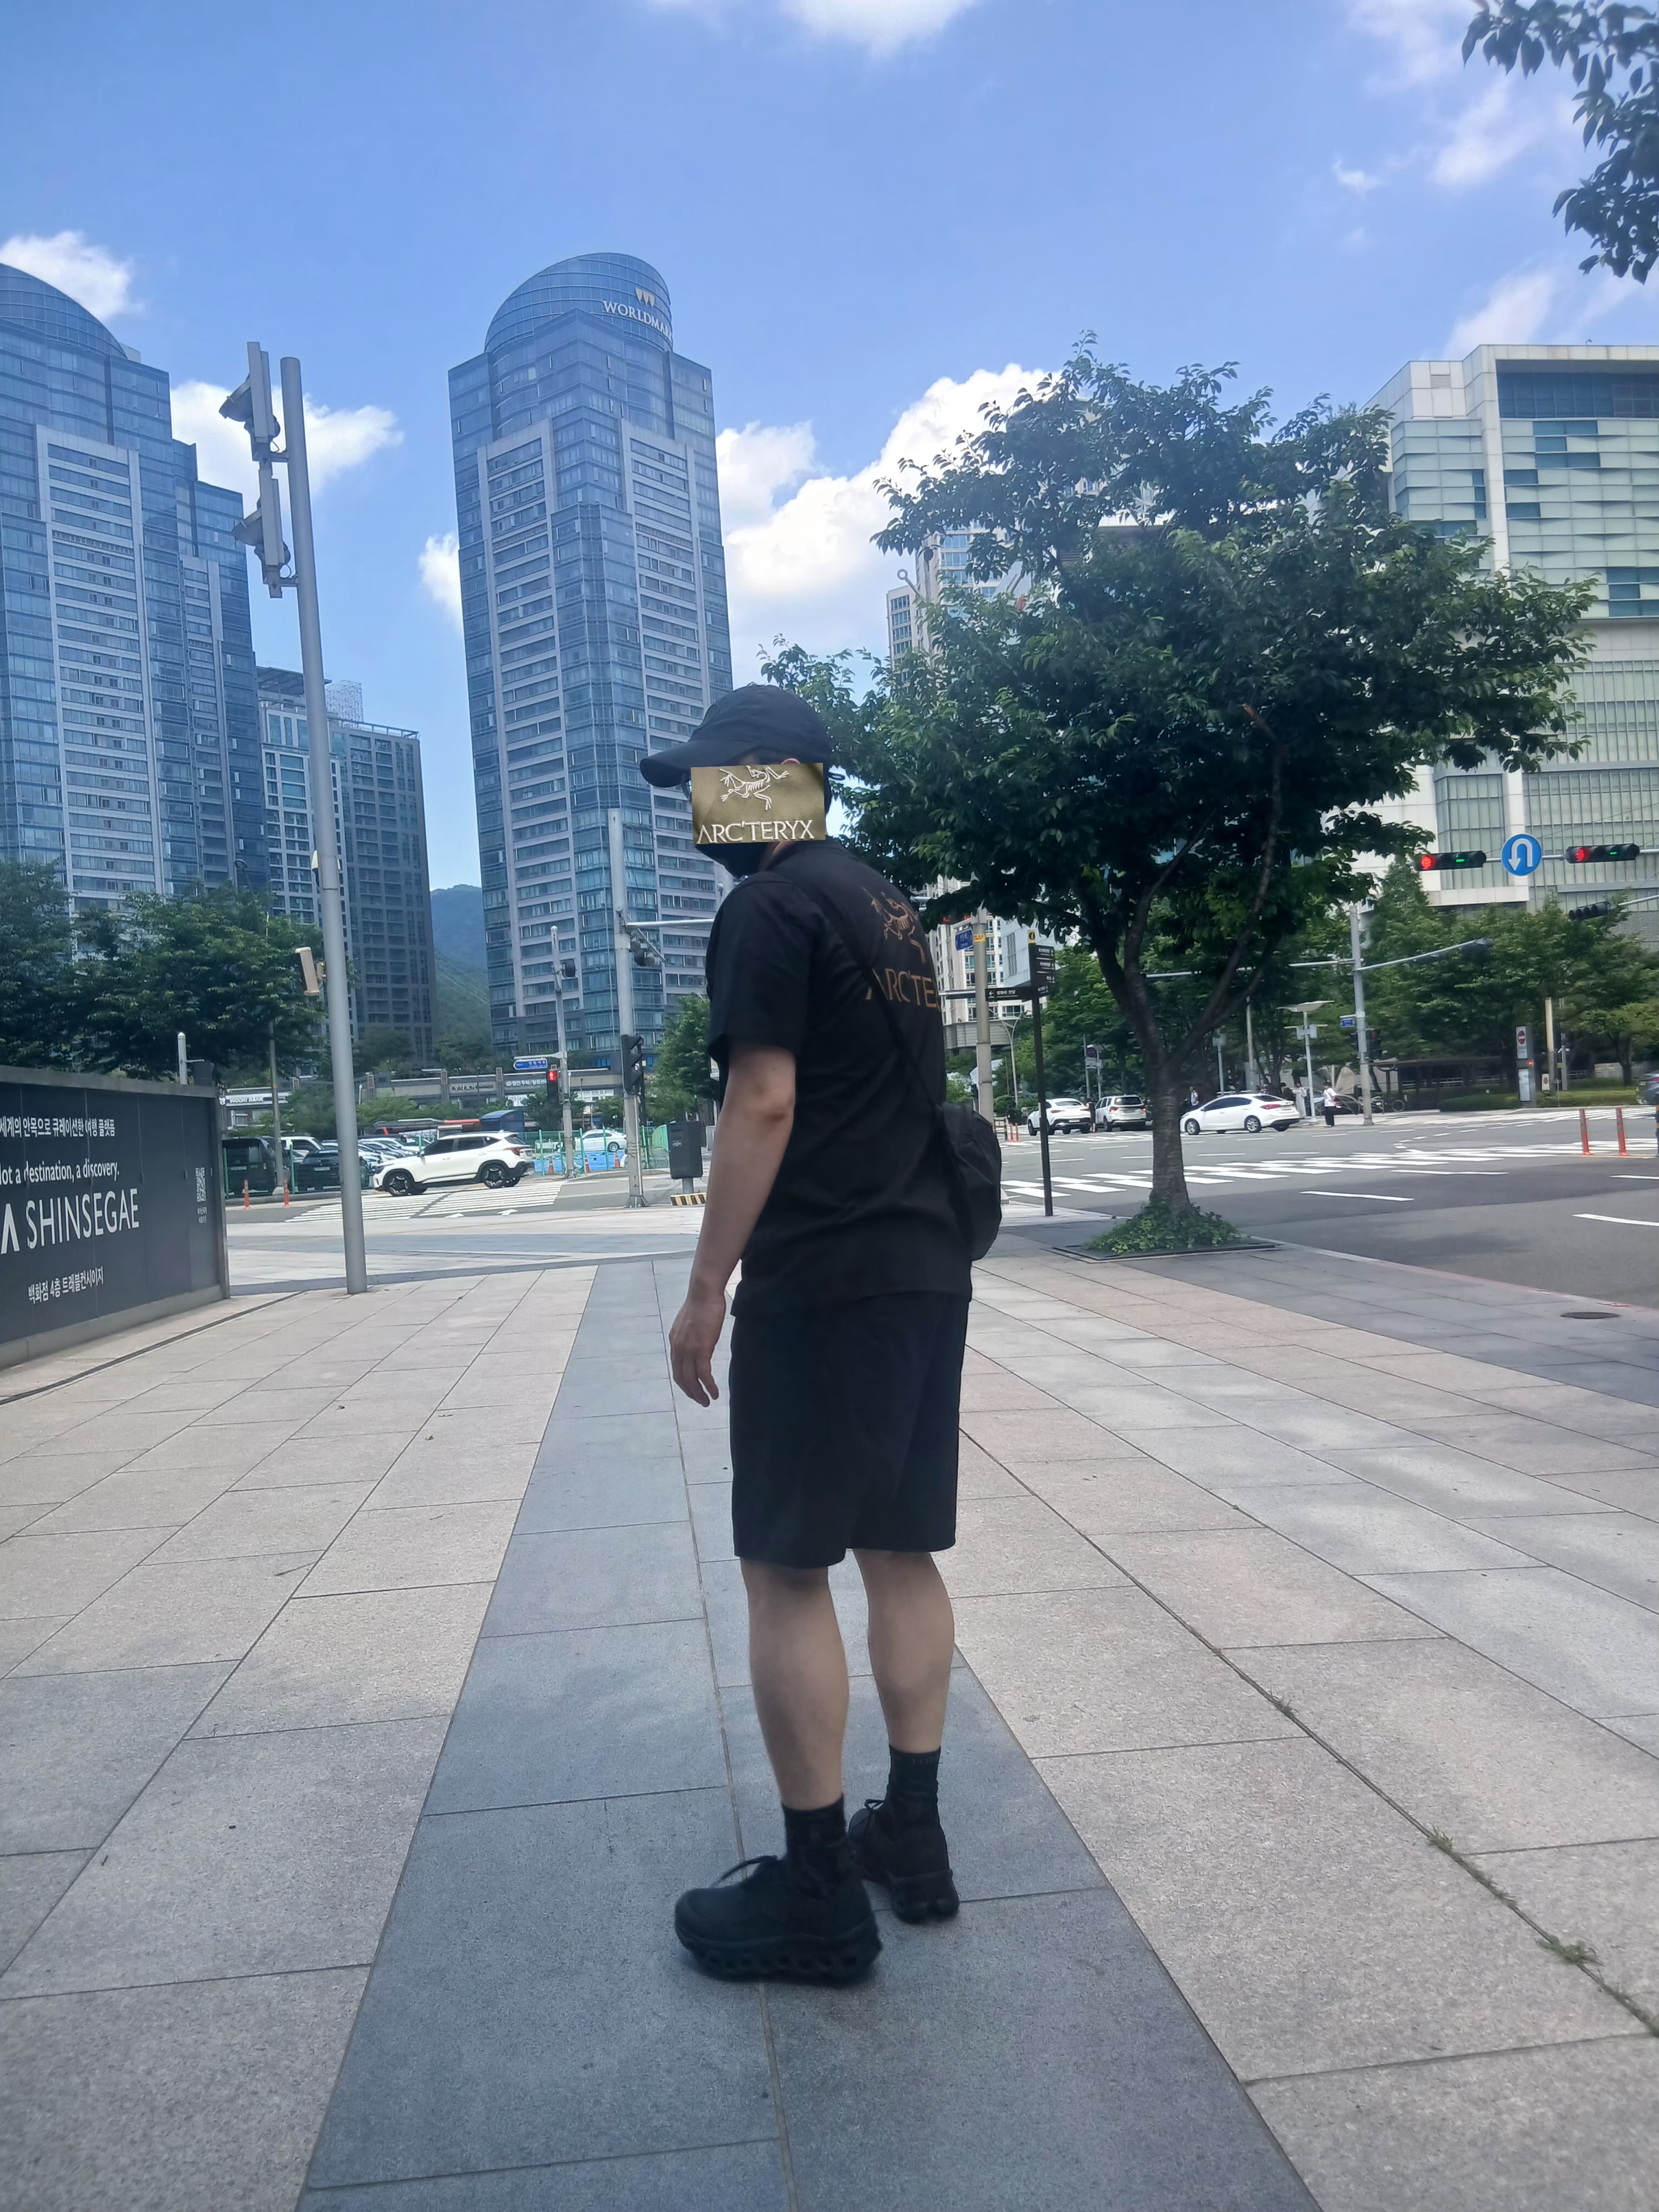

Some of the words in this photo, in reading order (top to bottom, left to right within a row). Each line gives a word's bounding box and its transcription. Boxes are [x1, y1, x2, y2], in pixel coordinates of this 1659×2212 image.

[22, 1116, 52, 1137] 안목으로
[52, 1117, 84, 1137] 큐레이션한
[85, 1117, 98, 1137] 여행
[98, 1118, 115, 1137] 플랫폼
[15, 1168, 22, 1185] a
[23, 1159, 74, 1183] destination,
[76, 1164, 81, 1179] a
[83, 1158, 119, 1181] discovery.
[26, 1188, 140, 1249] SHINSEGAE
[28, 1280, 49, 1304] 백화점
[50, 1277, 61, 1298] 4층
